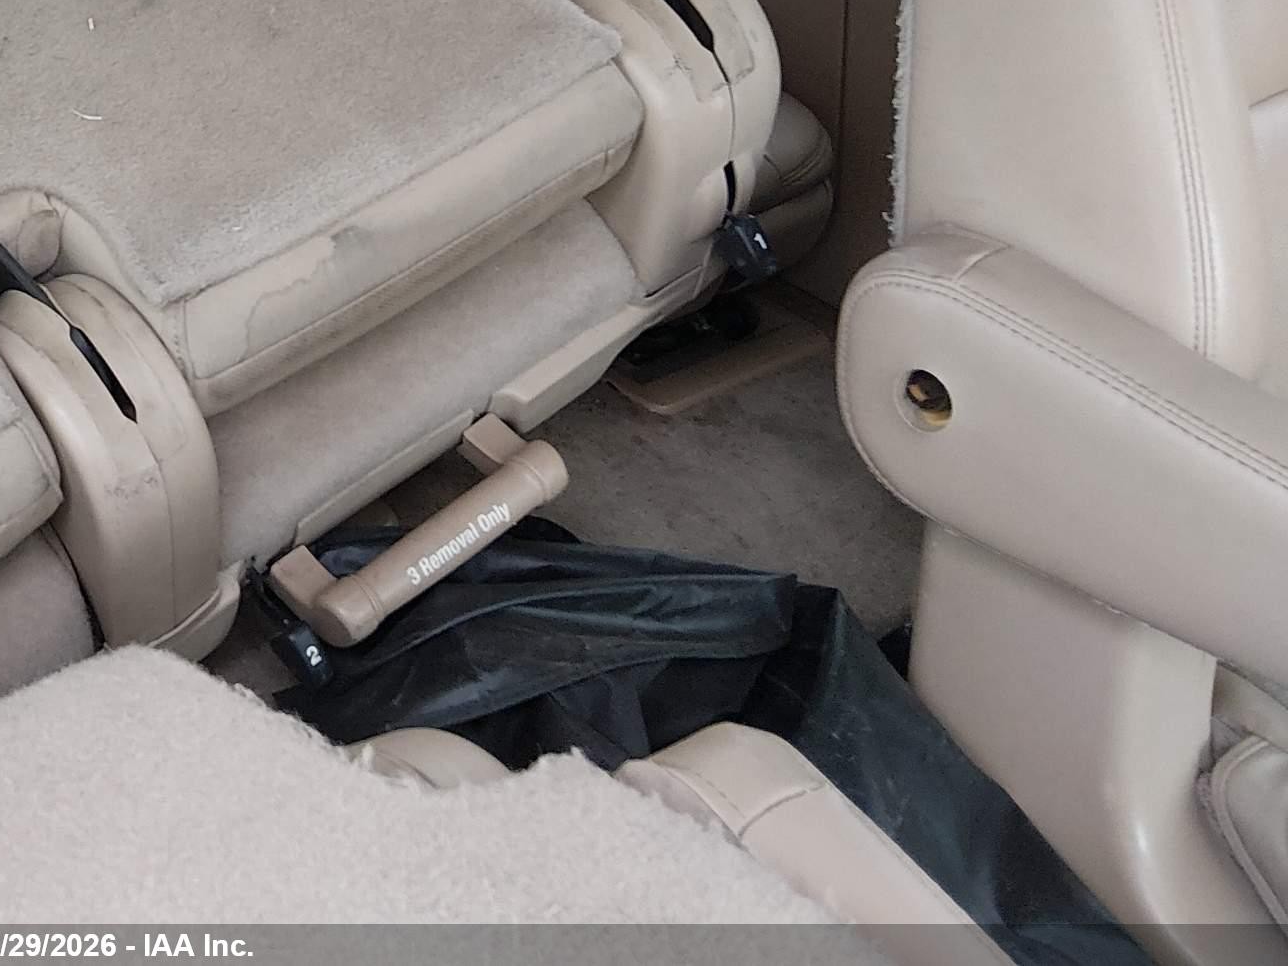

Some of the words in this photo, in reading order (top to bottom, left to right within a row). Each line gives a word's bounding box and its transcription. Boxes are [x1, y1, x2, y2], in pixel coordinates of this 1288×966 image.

[754, 233, 768, 249] 1
[406, 566, 421, 585] 3
[418, 522, 480, 577] Removal
[477, 502, 510, 532] Only
[306, 645, 322, 666] 2
